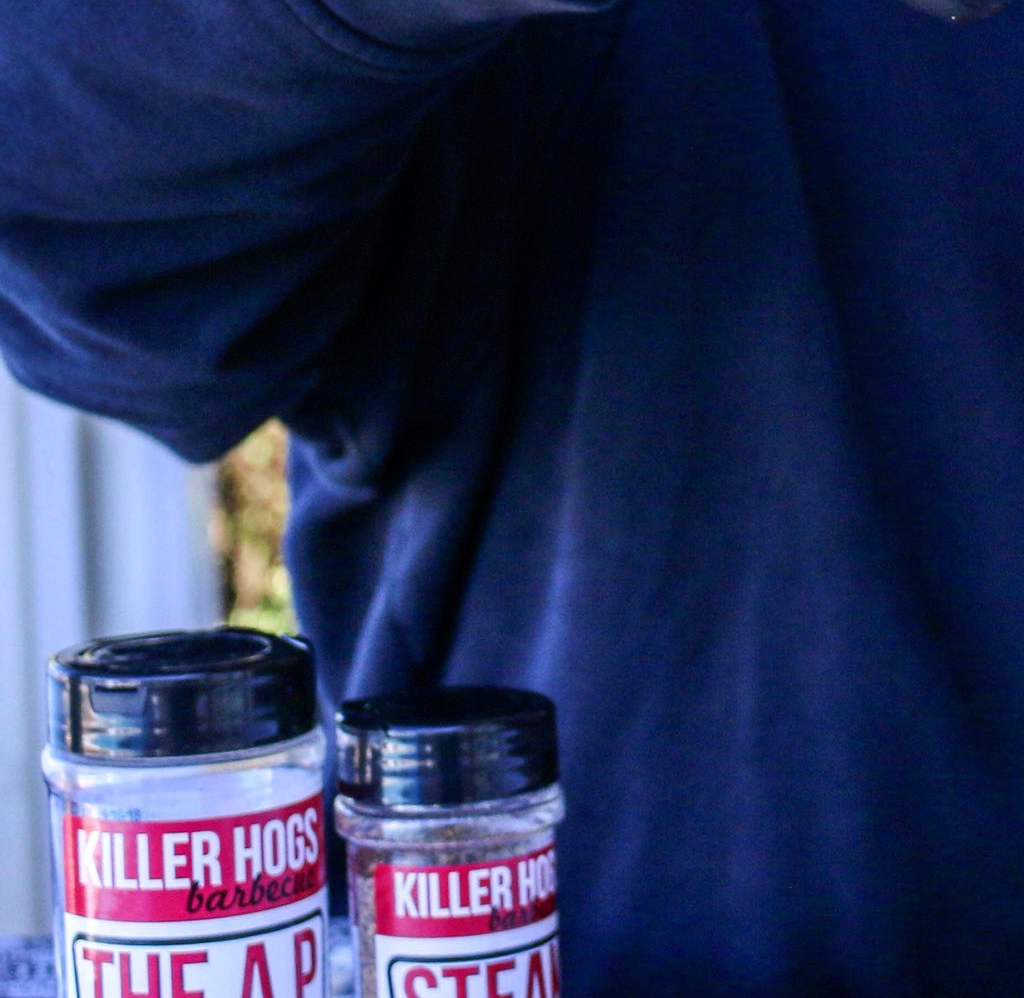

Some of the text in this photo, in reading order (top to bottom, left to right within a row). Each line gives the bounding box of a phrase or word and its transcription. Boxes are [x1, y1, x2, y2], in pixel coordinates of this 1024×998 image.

[77, 807, 319, 891] KILLER HOGS
[185, 869, 316, 914] barbecue
[394, 865, 514, 919] KILLER
[83, 948, 209, 998] THE
